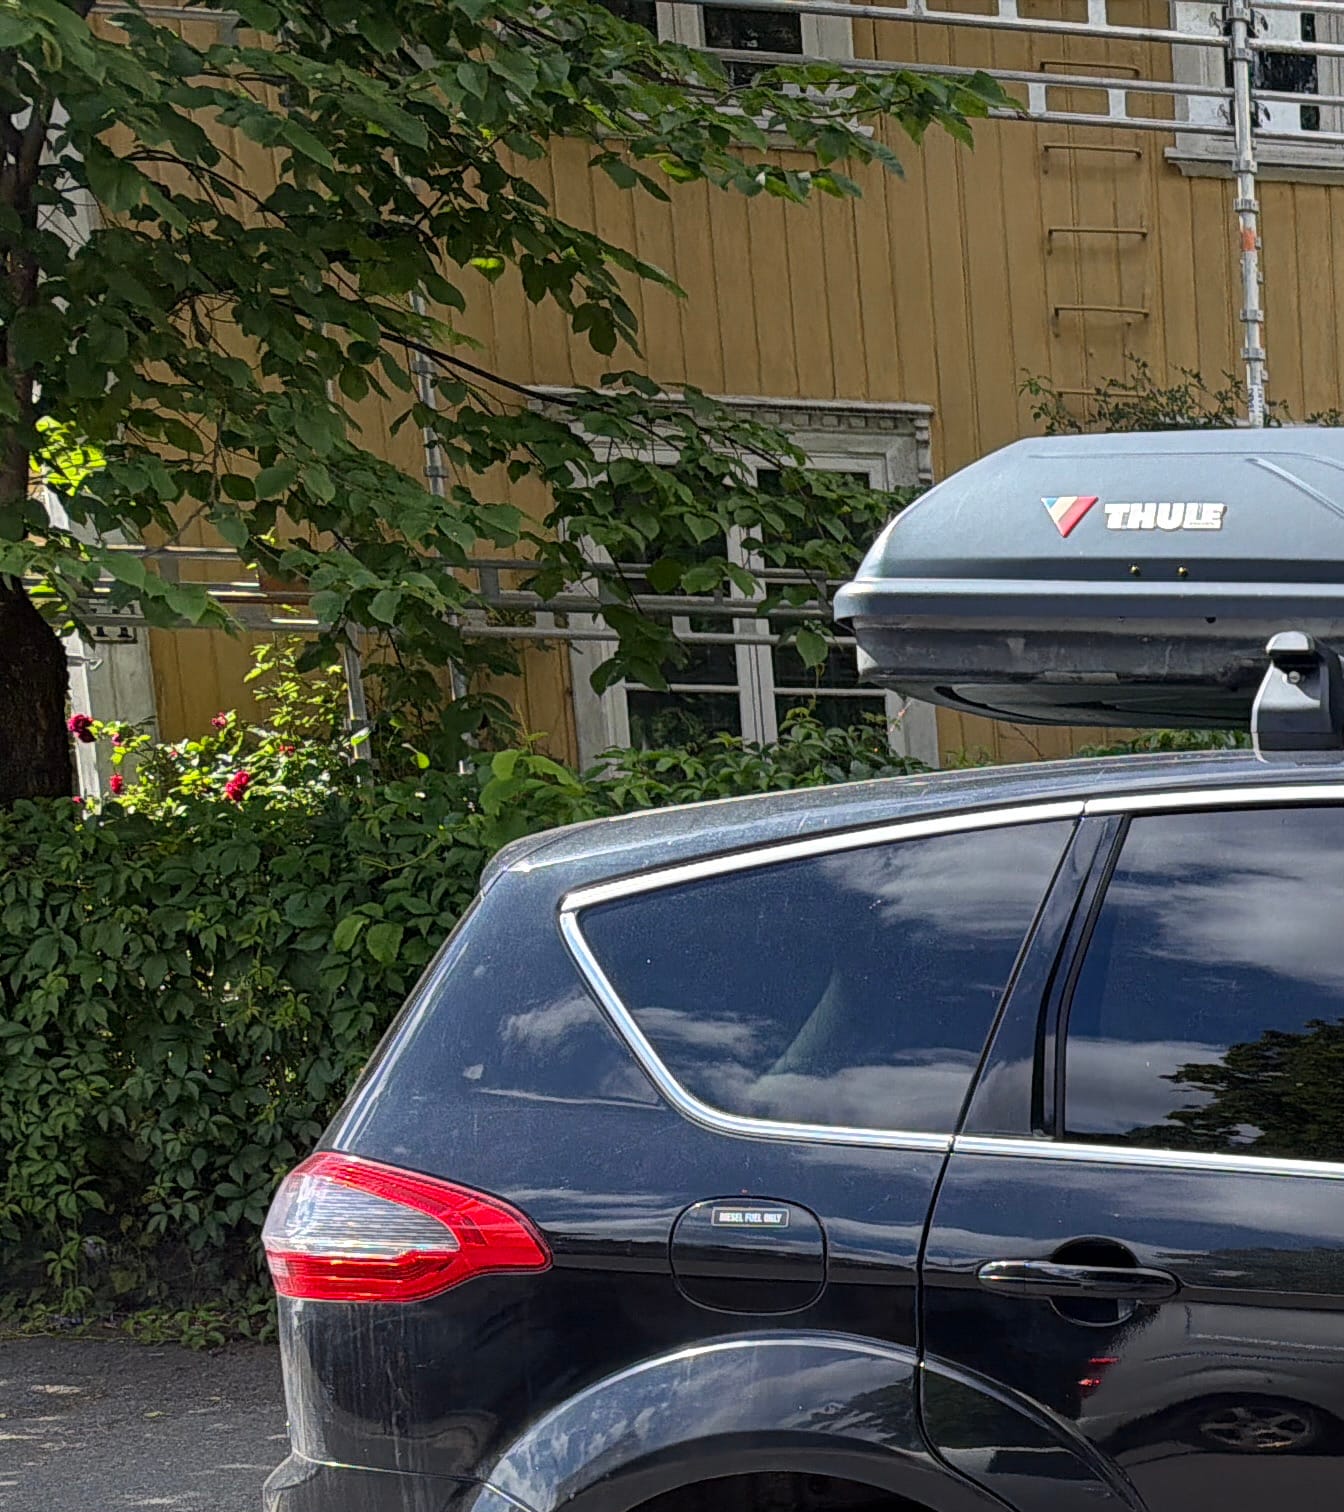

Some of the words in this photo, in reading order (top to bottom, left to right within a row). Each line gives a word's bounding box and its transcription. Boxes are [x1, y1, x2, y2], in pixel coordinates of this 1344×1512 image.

[1104, 503, 1227, 532] THULE
[719, 1212, 743, 1222] DIESEL
[745, 1213, 762, 1223] FUEL
[764, 1213, 782, 1223] ONLY
